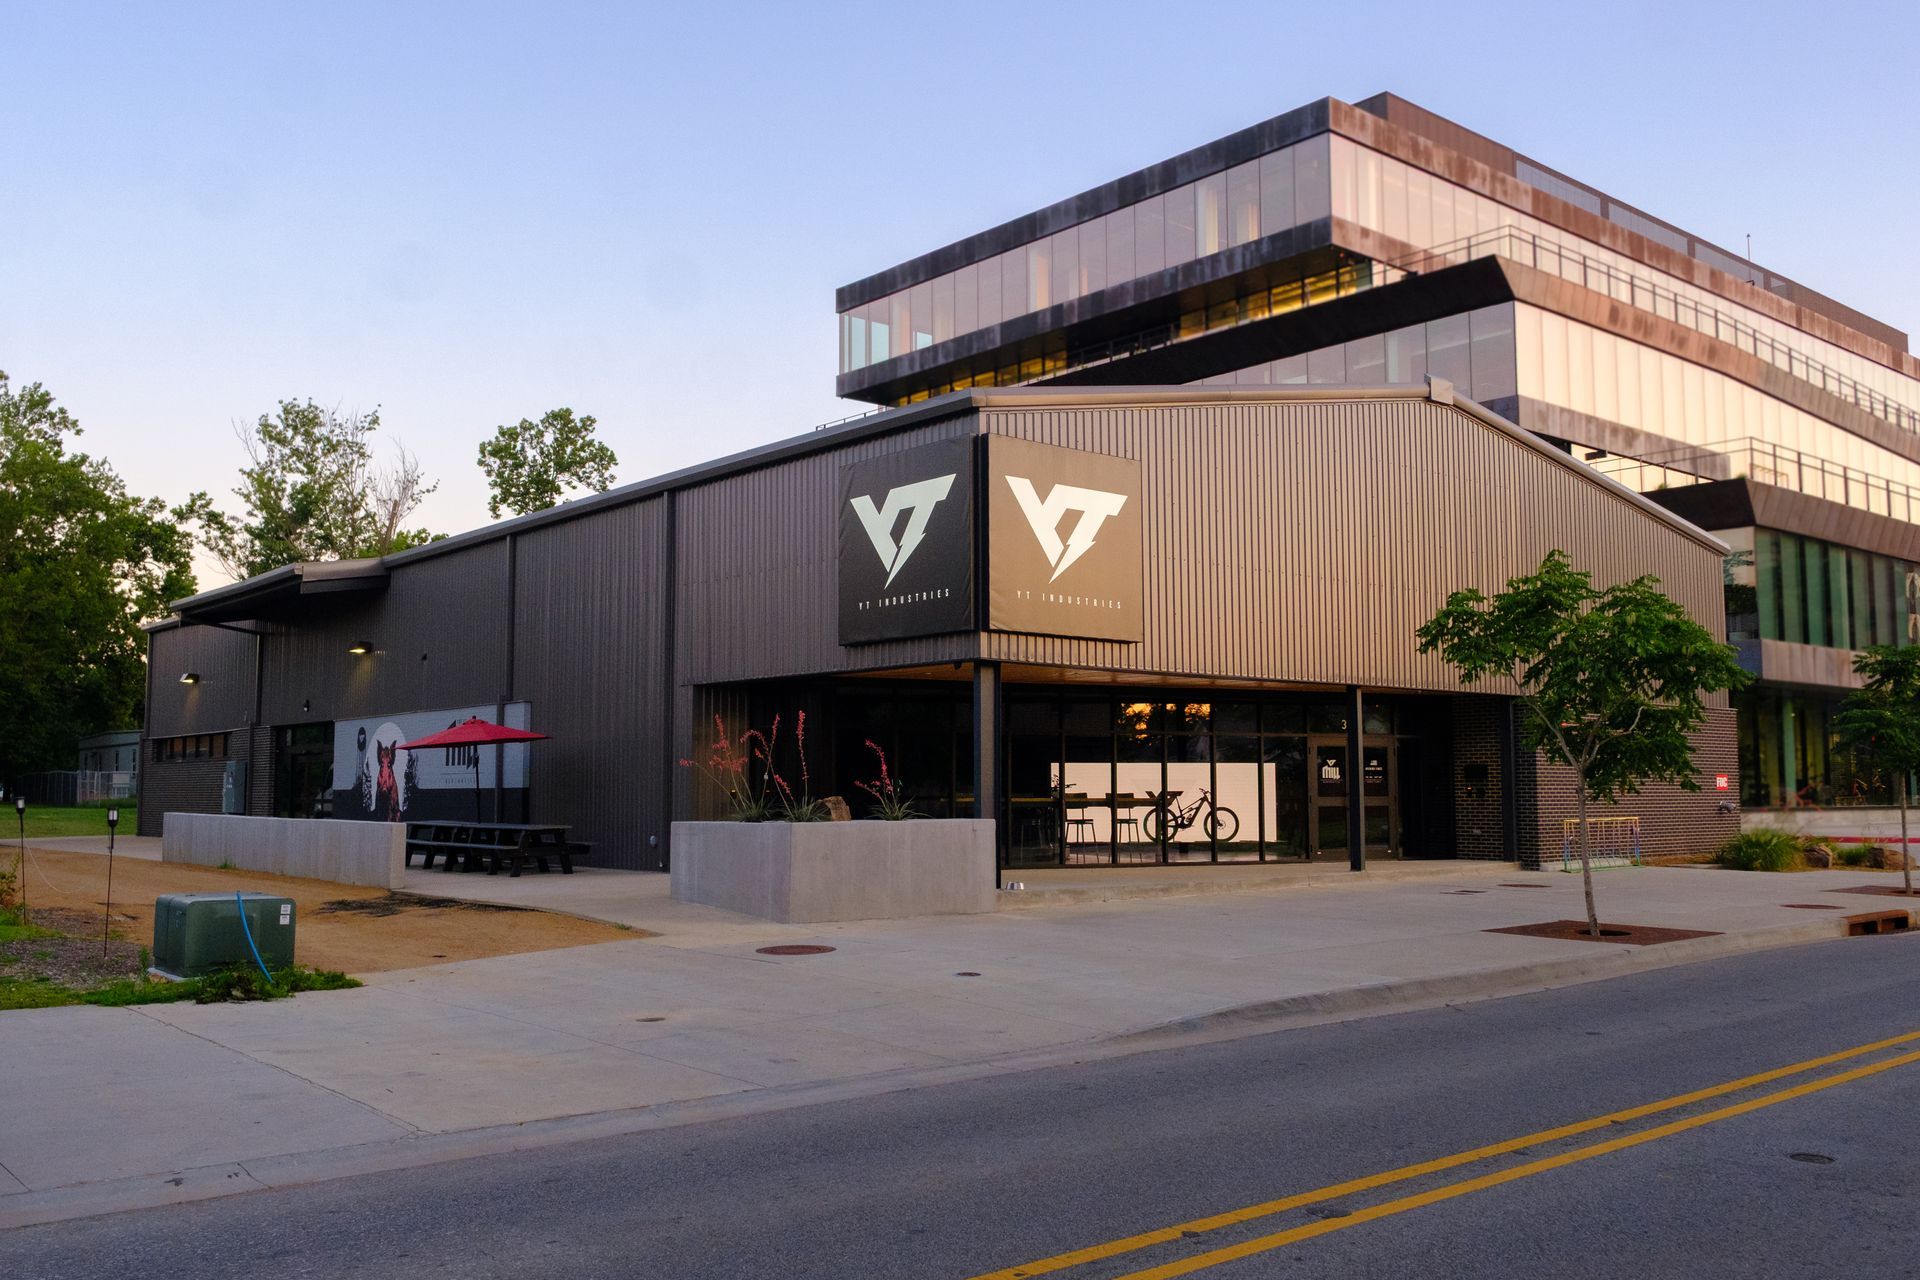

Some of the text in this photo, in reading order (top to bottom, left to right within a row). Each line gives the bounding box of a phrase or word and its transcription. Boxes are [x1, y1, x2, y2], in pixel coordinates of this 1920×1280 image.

[858, 588, 949, 611] YT INDUSTRIES
[1016, 590, 1121, 609] YT INDUSTRIES
